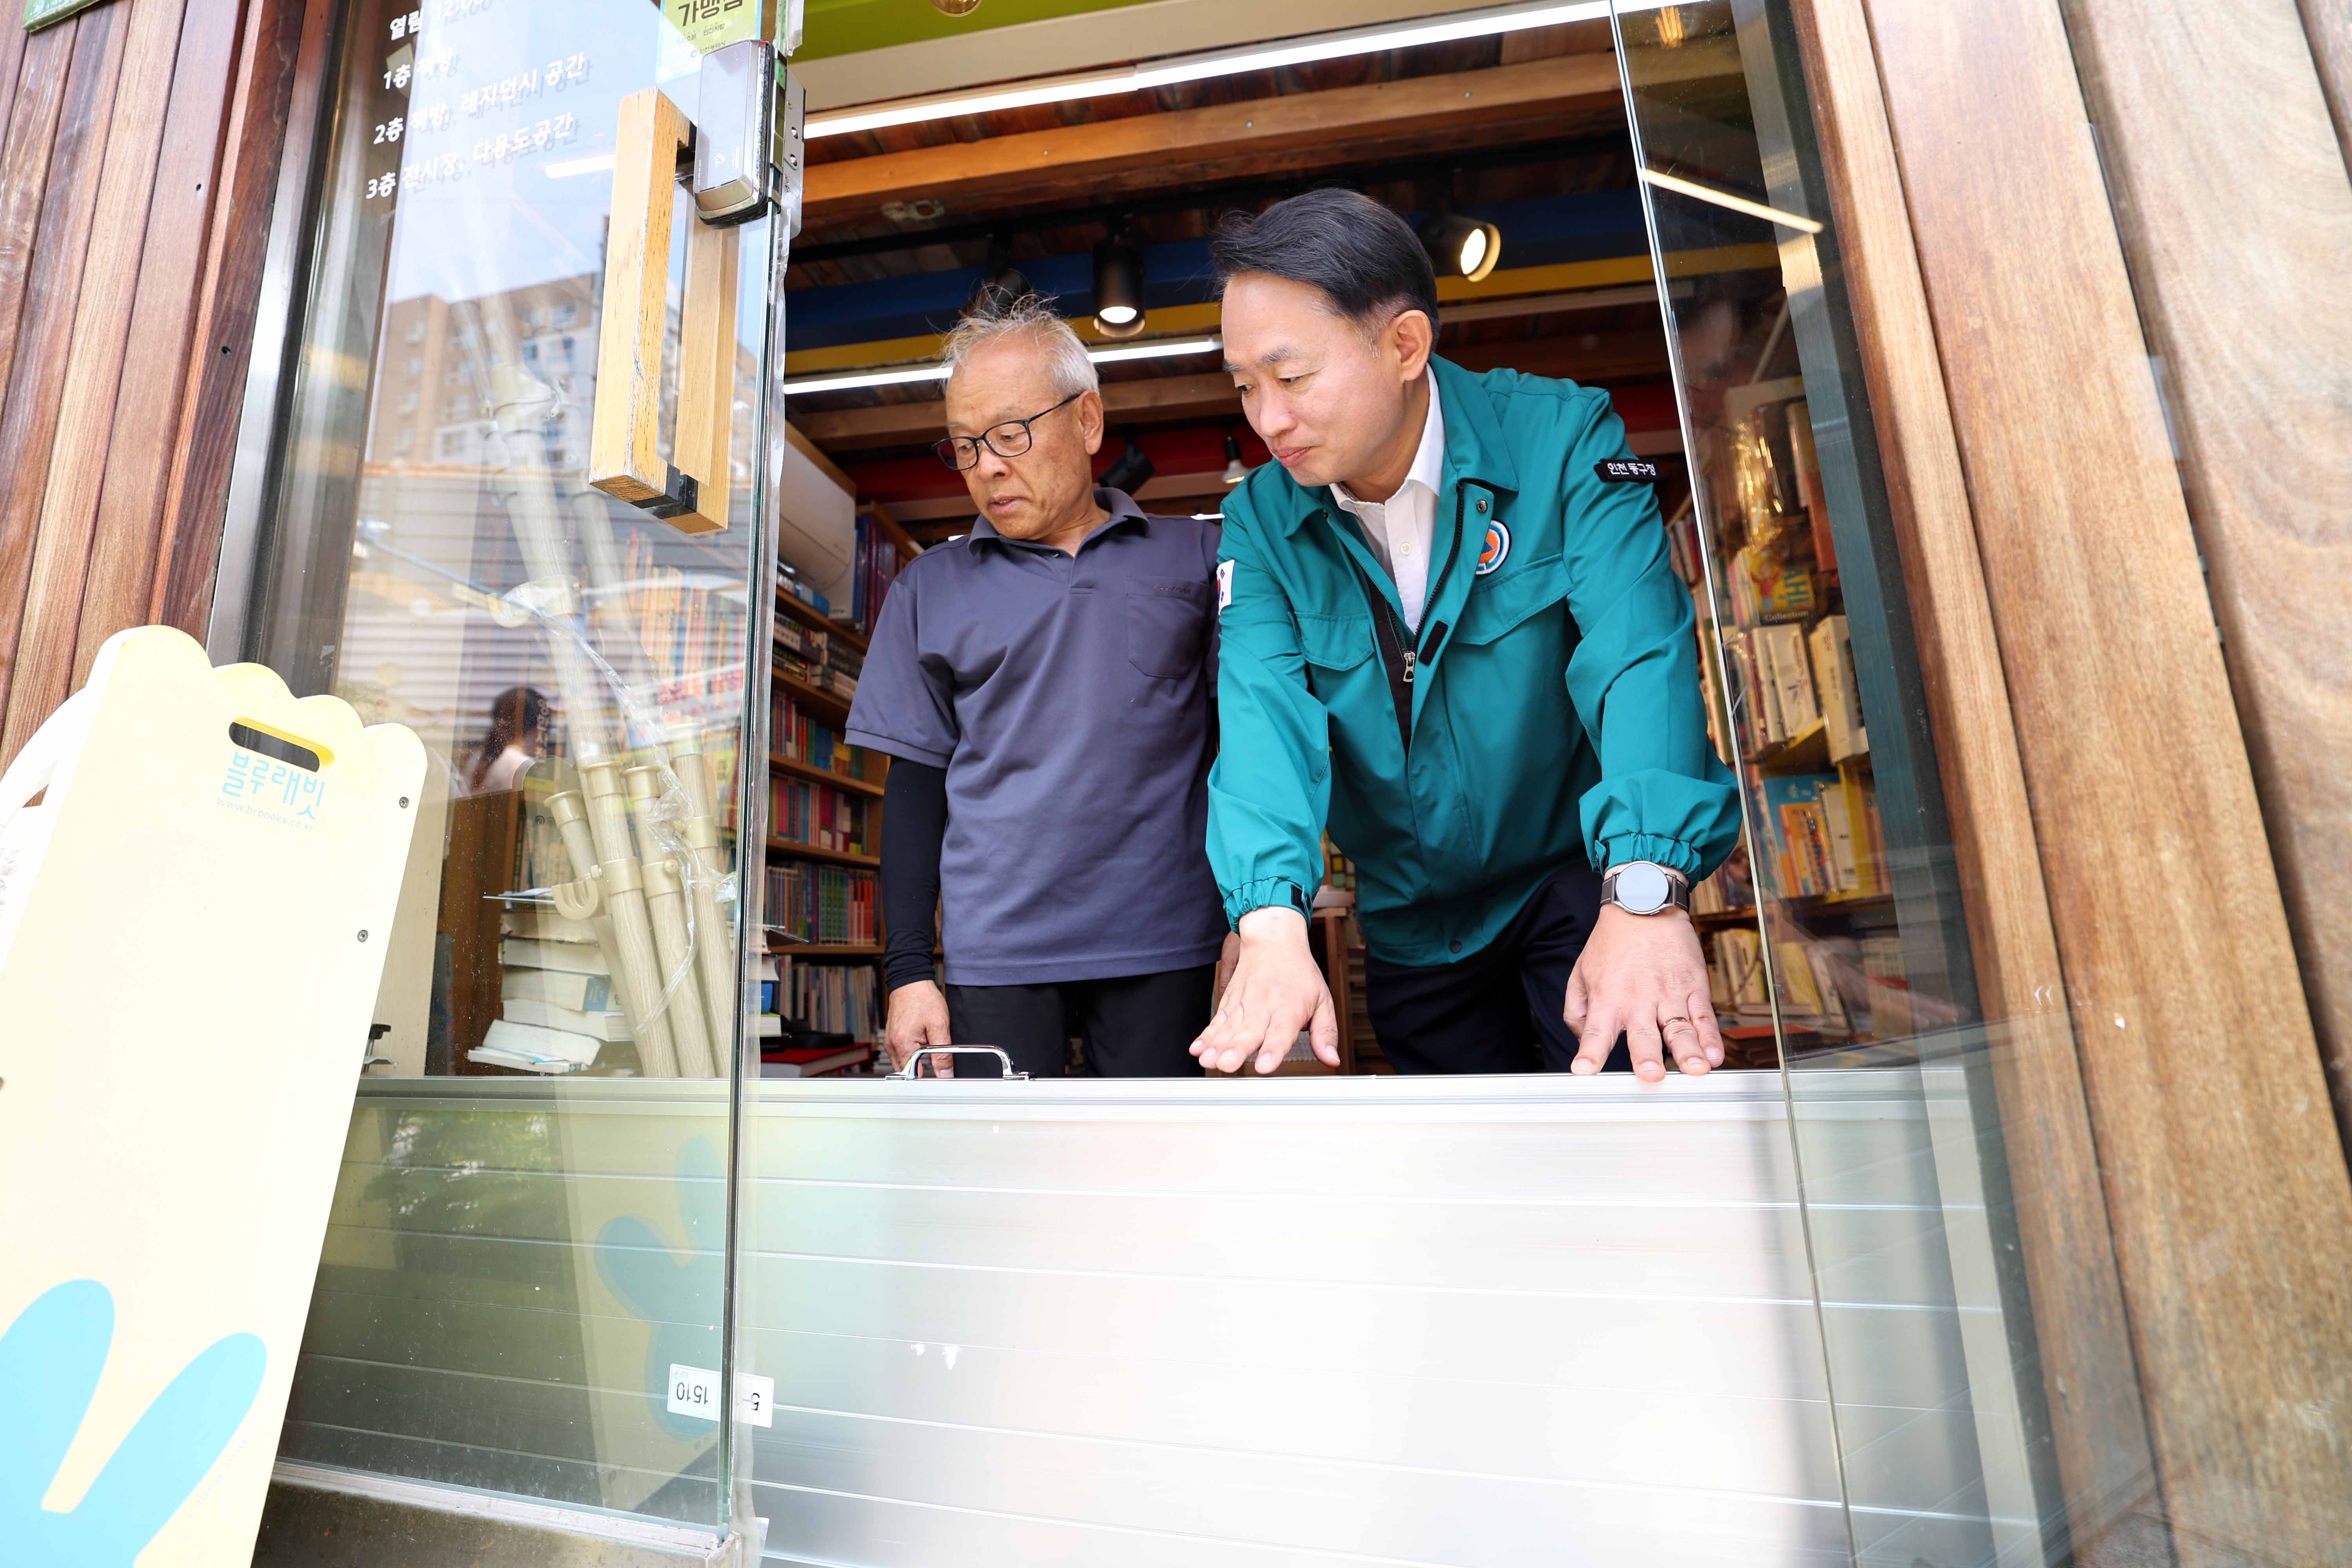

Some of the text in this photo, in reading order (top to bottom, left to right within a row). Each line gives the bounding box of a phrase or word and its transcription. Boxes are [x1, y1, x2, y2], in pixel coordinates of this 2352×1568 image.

[390, 8, 423, 40] 열림
[383, 47, 454, 90] 1층 책방
[373, 117, 403, 144] 2층
[544, 51, 586, 86] 공간
[366, 172, 396, 199] 3층
[472, 111, 573, 163] 다용도공간
[1607, 463, 1656, 476] 인천 동구청
[222, 751, 325, 820] 블루래빗
[218, 798, 315, 831] www.brbooks.co.kr
[676, 1382, 708, 1405] 1510
